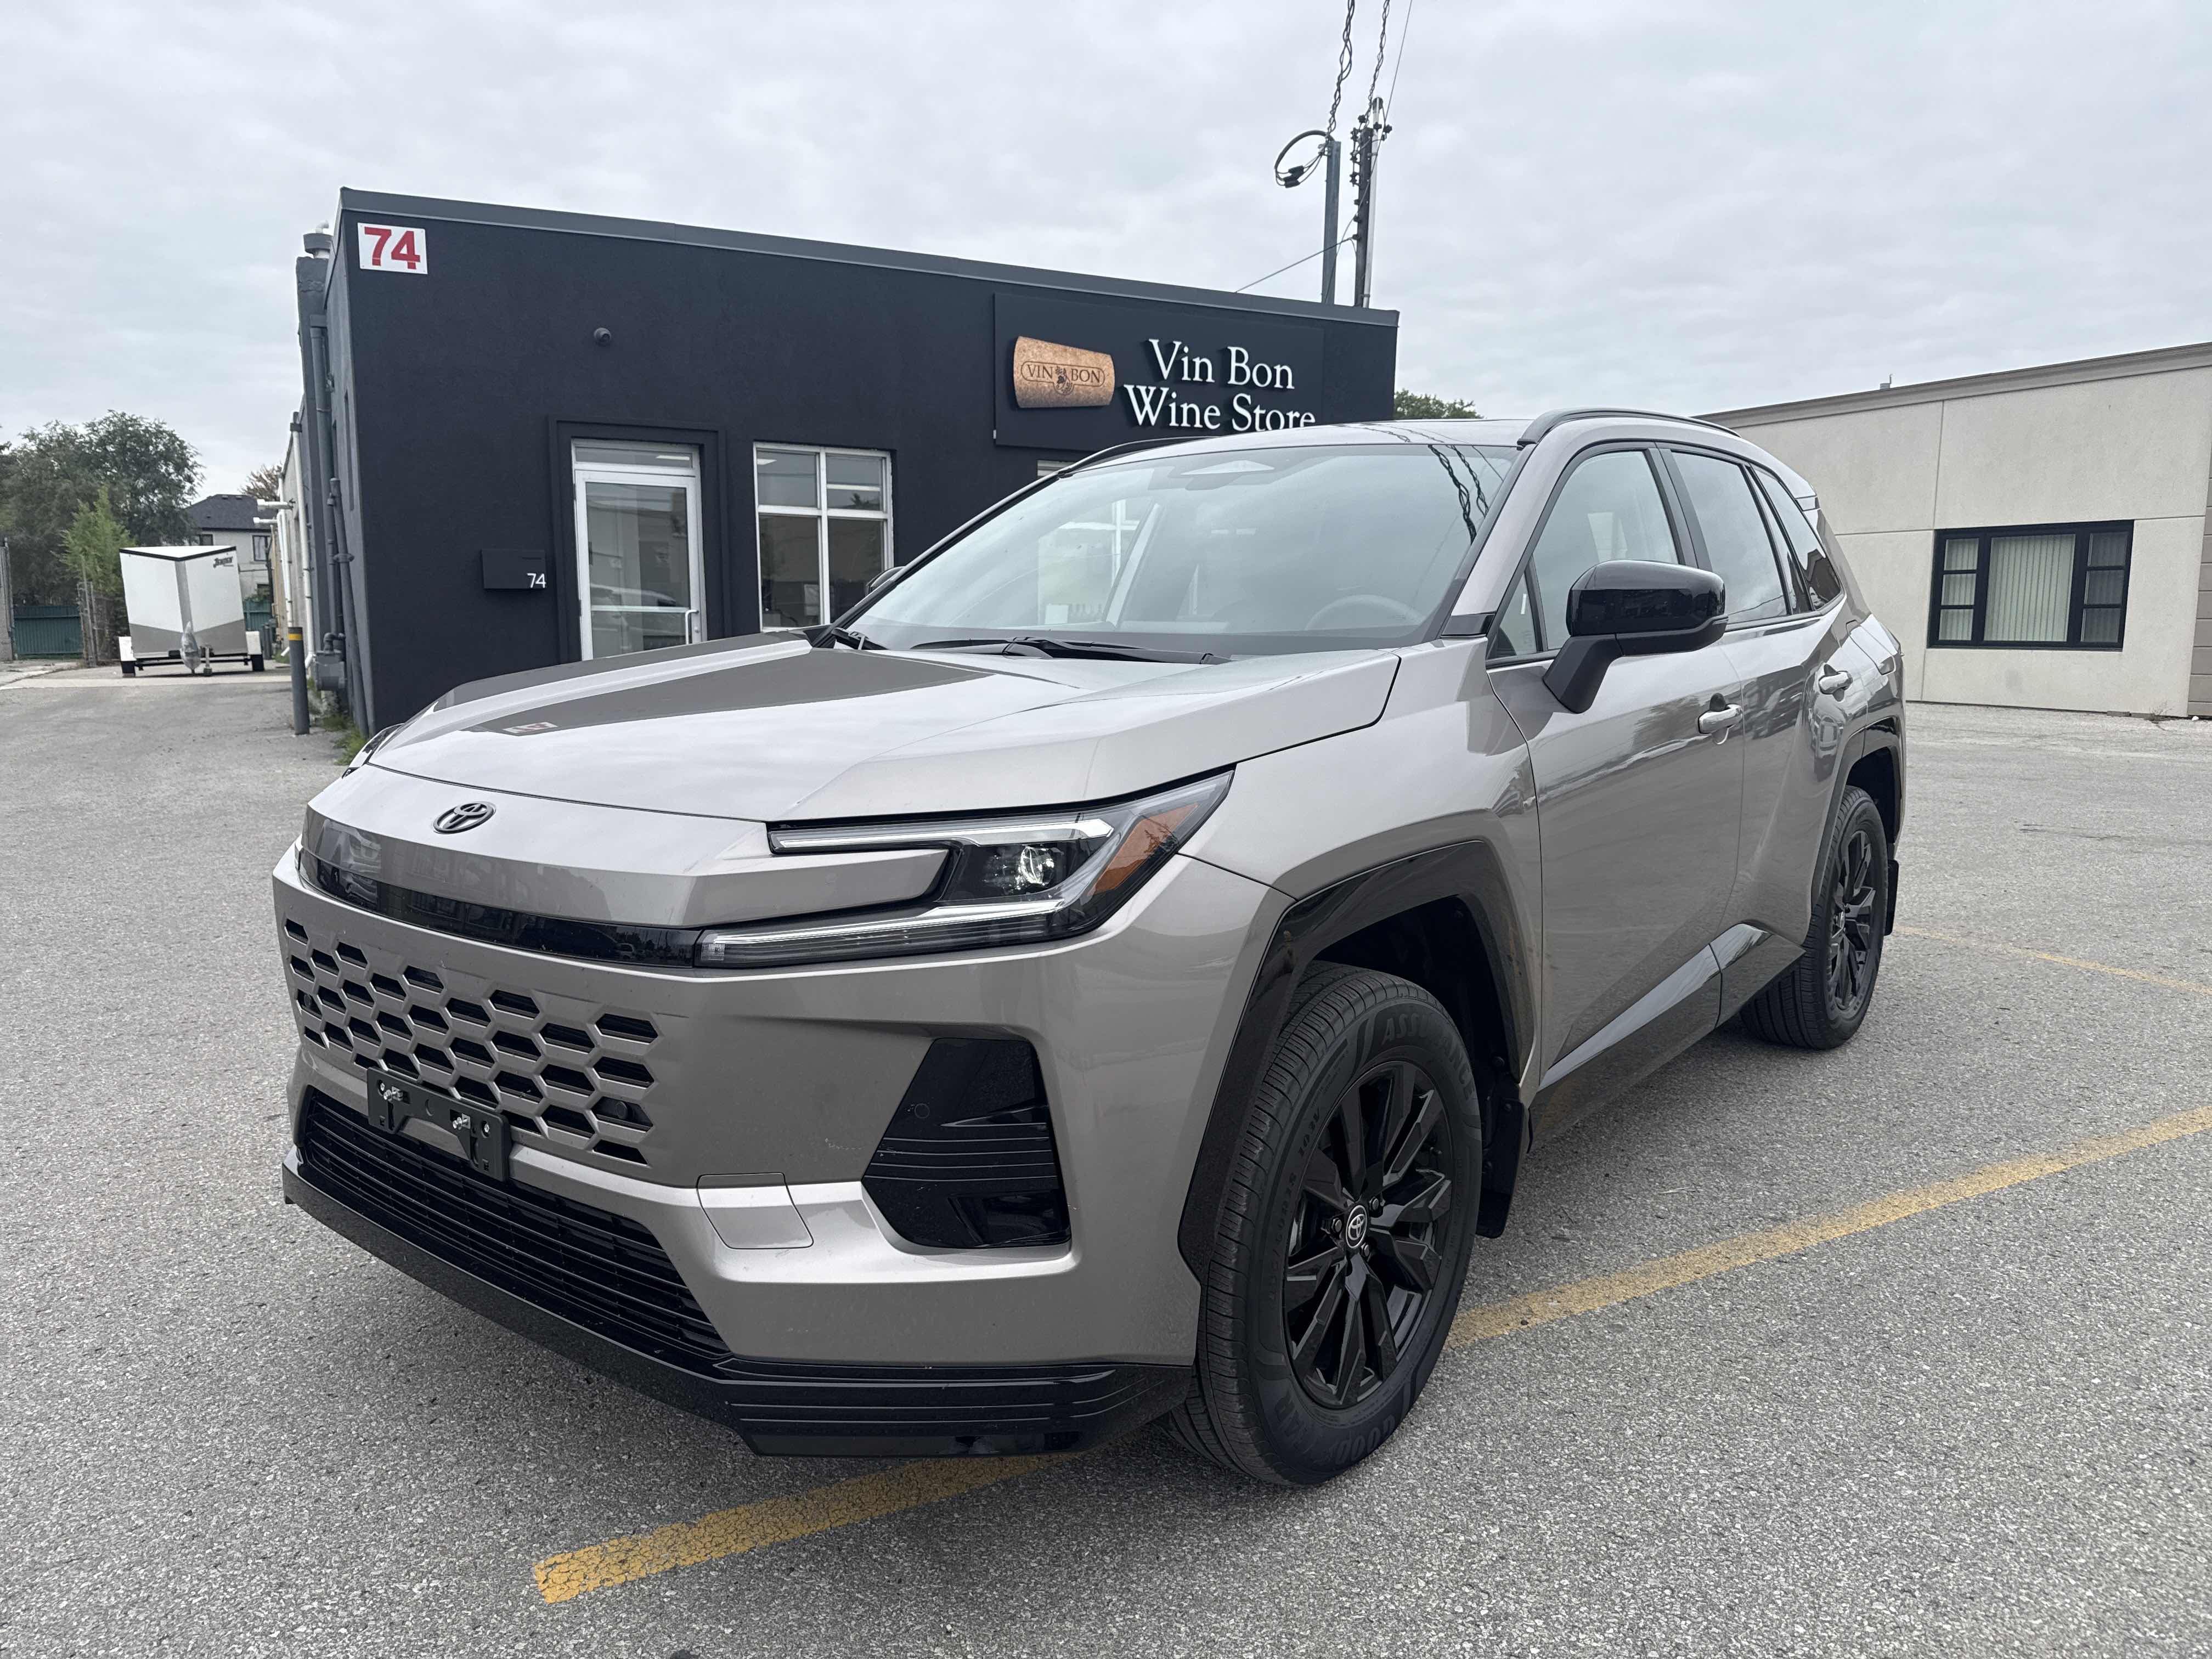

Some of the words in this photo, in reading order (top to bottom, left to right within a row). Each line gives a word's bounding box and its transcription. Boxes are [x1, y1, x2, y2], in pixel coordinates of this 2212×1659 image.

[364, 227, 421, 269] 74
[1027, 364, 1053, 379] VIN
[1071, 368, 1101, 383] BON
[1149, 338, 1215, 382] Vin
[1227, 346, 1295, 389] Bon
[1124, 385, 1221, 430] Wine
[1232, 393, 1316, 432] Store
[527, 573, 546, 588] 74
[1381, 1012, 1475, 1101] ASSUANCE
